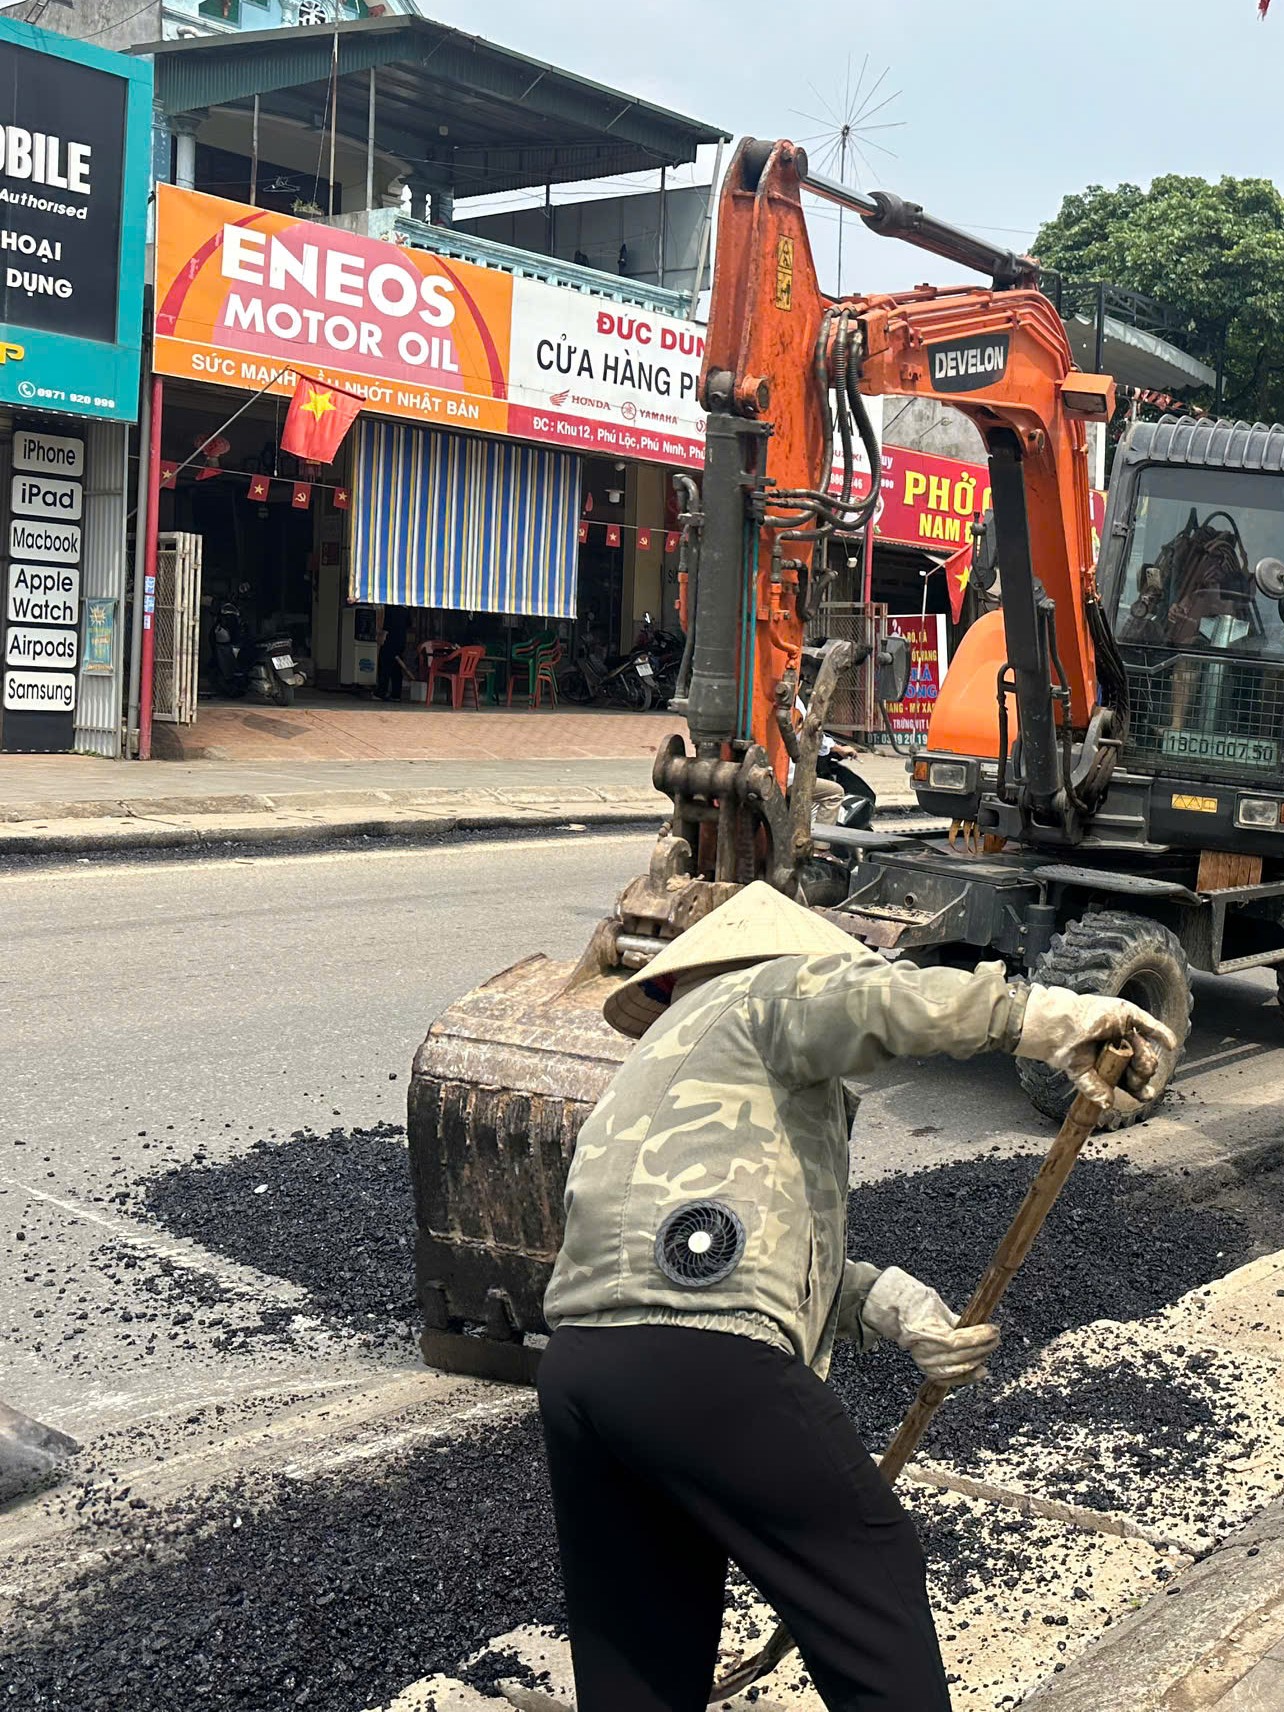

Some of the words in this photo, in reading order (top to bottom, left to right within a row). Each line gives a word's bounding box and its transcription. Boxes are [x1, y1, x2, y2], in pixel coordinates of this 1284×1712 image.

[0, 124, 91, 195] BILE
[0, 188, 88, 220] Authorised
[1, 230, 62, 263] HOẠI
[6, 268, 73, 298] DỤNG
[221, 223, 456, 328] ENEOS
[223, 293, 383, 357] MOTOR
[397, 330, 459, 373] OIL
[597, 311, 652, 345] ĐỨC
[536, 333, 594, 379] CỬA
[602, 349, 671, 396] HÀNG
[935, 345, 1004, 379] DEVELON
[191, 353, 236, 376] SỨC
[241, 363, 297, 388] MẠNH
[397, 392, 442, 414] NHẬT
[446, 400, 480, 419] BẢN
[571, 395, 611, 411] HONDA
[639, 409, 678, 424] YAMAHA
[557, 420, 578, 436] Khu
[597, 428, 616, 444] Phú
[23, 439, 76, 466] iPhone
[881, 455, 893, 470] uy
[21, 483, 74, 510] iPad
[903, 470, 977, 516] PHỞ
[13, 527, 78, 554] Macbook
[919, 513, 960, 543] NAM
[15, 568, 73, 596] Apple
[13, 597, 73, 621] Watch
[9, 633, 75, 660] Airpods
[8, 677, 73, 705] Samsung
